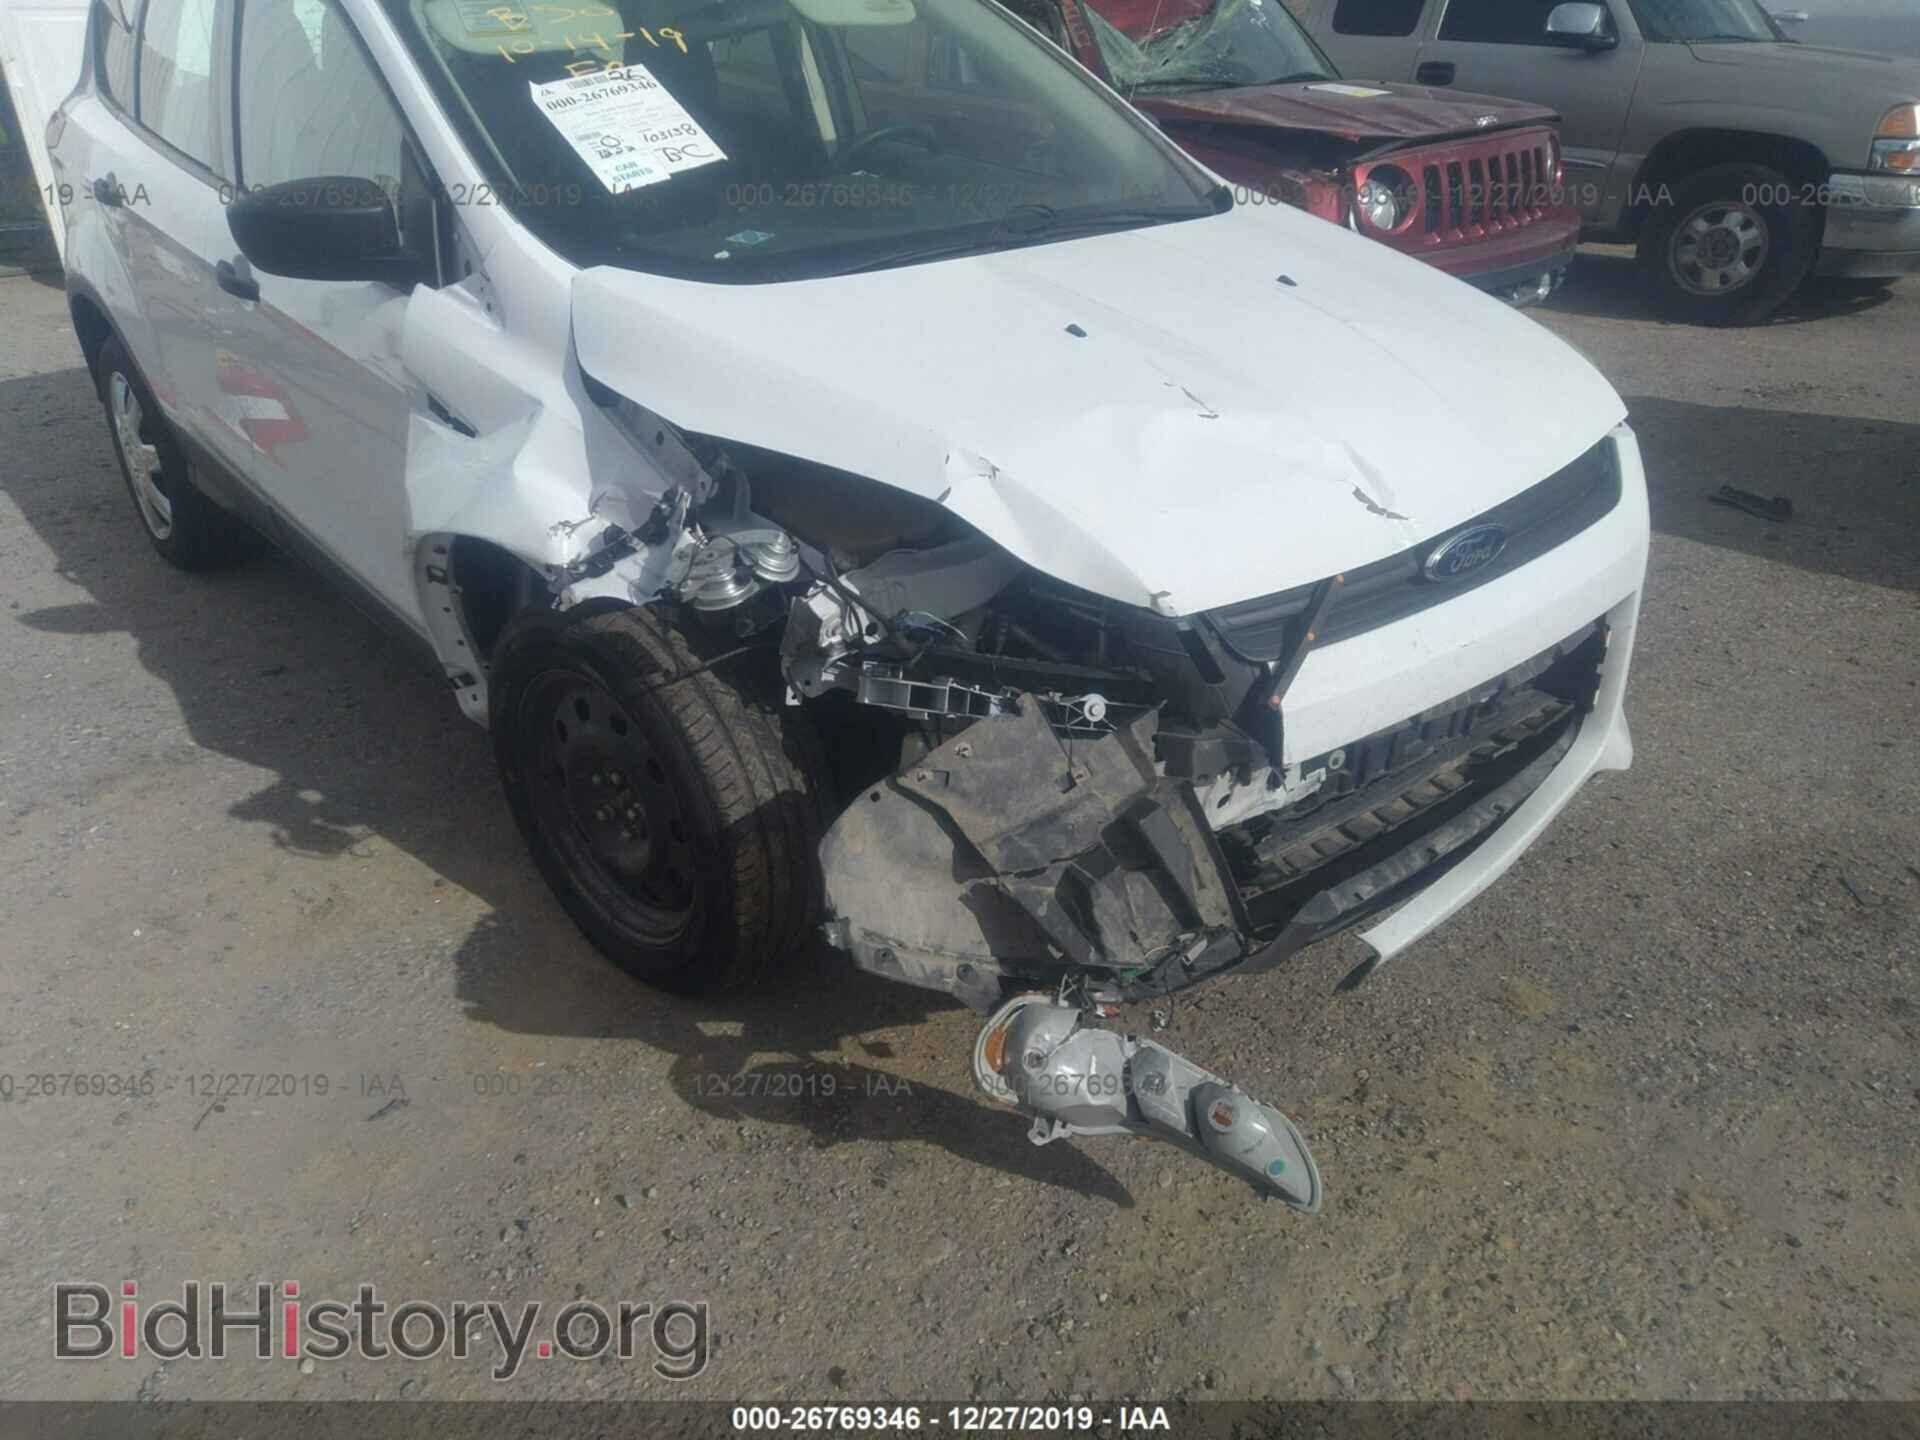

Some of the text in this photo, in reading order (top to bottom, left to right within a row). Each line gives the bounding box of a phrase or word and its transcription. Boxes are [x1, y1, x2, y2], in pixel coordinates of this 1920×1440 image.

[546, 81, 657, 111] 000-26769346
[615, 161, 637, 172] CAR
[612, 167, 653, 183] STARTS
